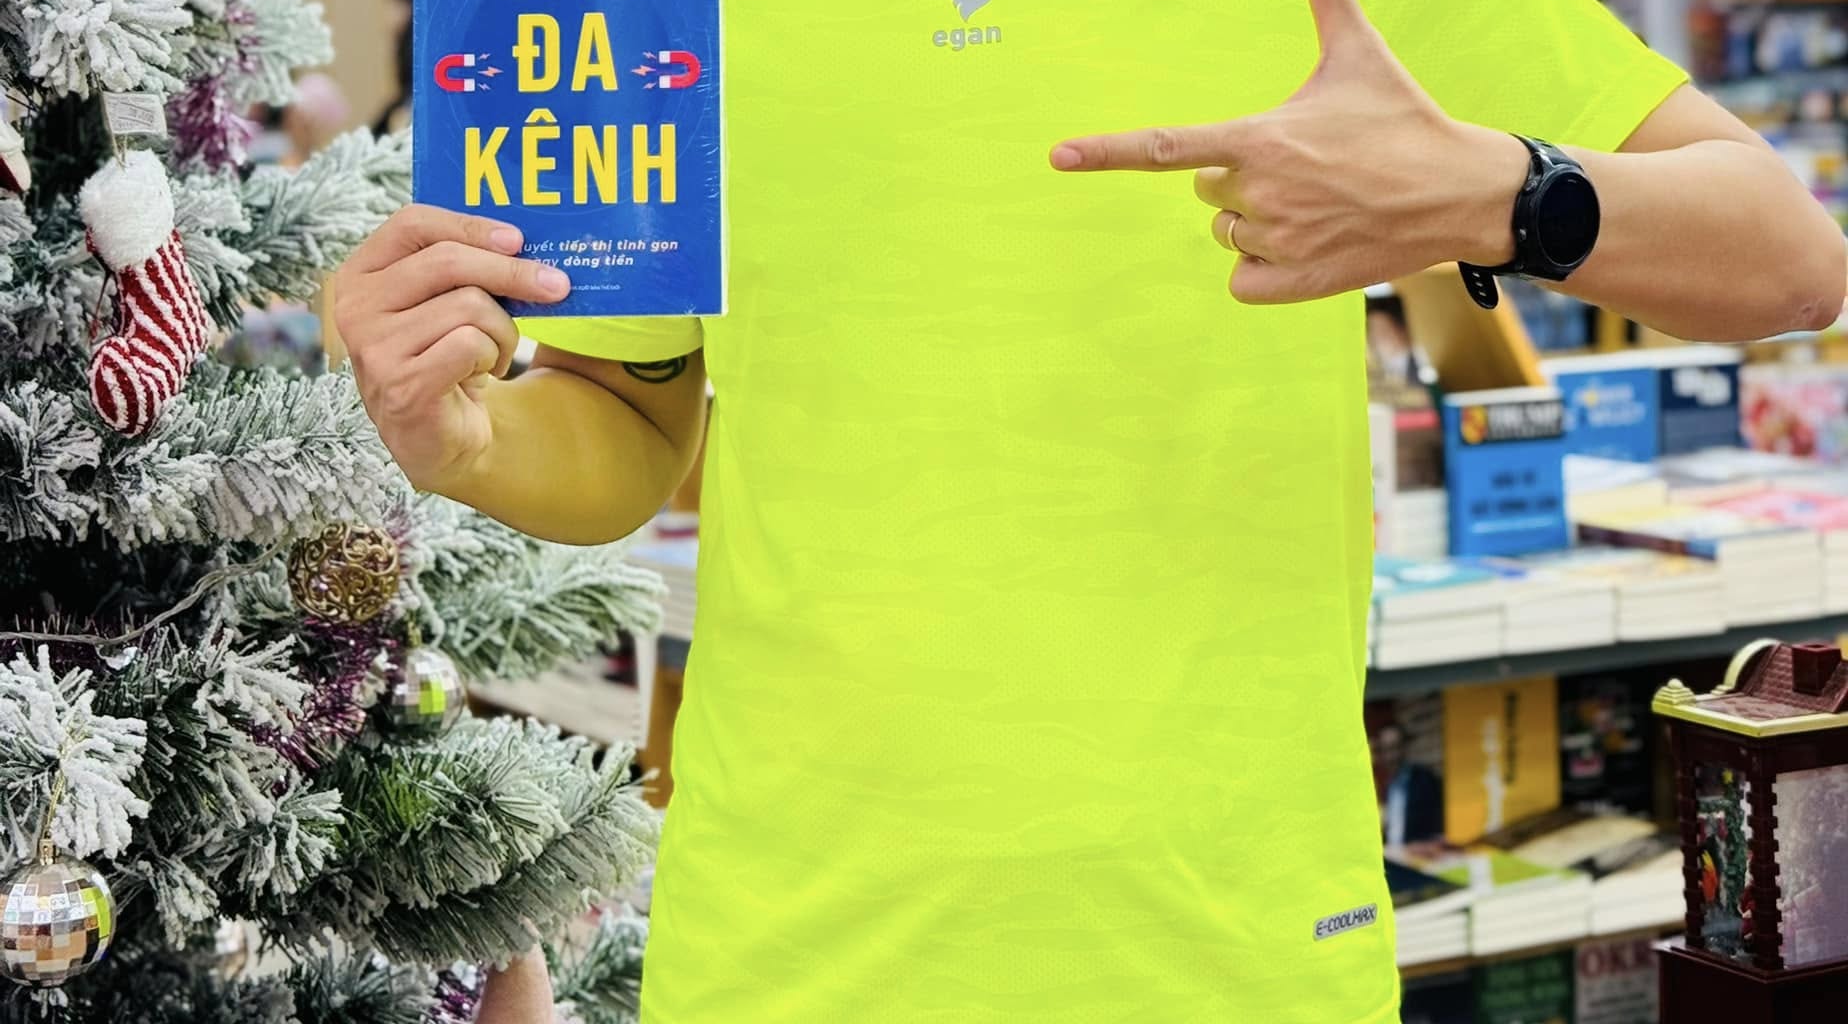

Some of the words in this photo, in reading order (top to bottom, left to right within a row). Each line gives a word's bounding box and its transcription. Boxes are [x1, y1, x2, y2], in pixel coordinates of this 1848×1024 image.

[932, 26, 1002, 52] egan
[511, 12, 619, 93] ĐA
[464, 108, 678, 207] KÊNH
[518, 238, 554, 254] uyết
[558, 239, 588, 254] tiếp
[591, 239, 612, 253] thị
[616, 239, 646, 251] tinh
[650, 239, 679, 253] gọn
[563, 255, 600, 269] dòng
